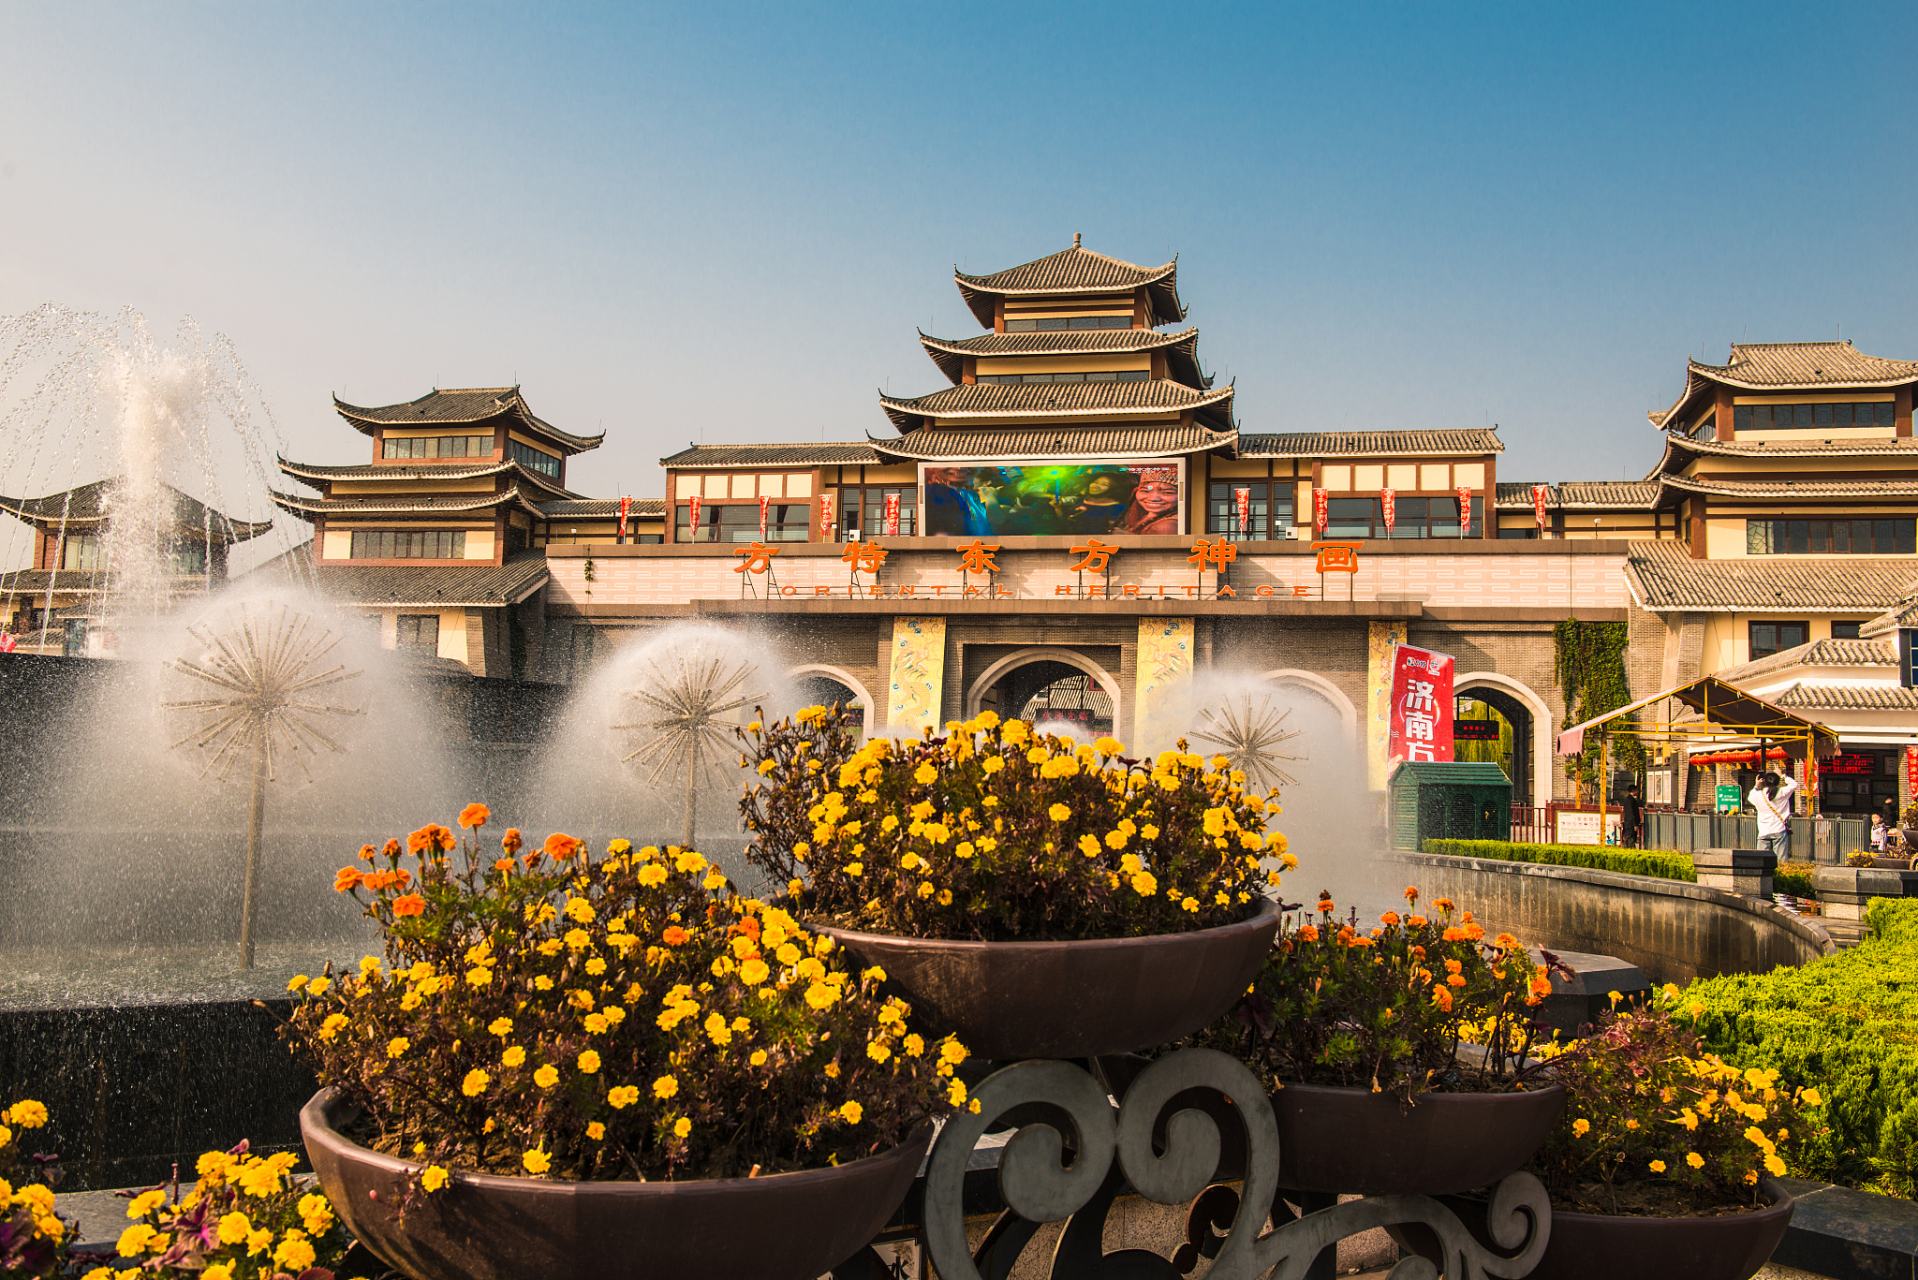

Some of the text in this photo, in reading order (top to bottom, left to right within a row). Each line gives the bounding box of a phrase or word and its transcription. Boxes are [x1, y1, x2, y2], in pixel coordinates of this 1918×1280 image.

[733, 538, 1365, 574] 方特东方神画
[781, 584, 1311, 597] ORIENTAL HERITAGE
